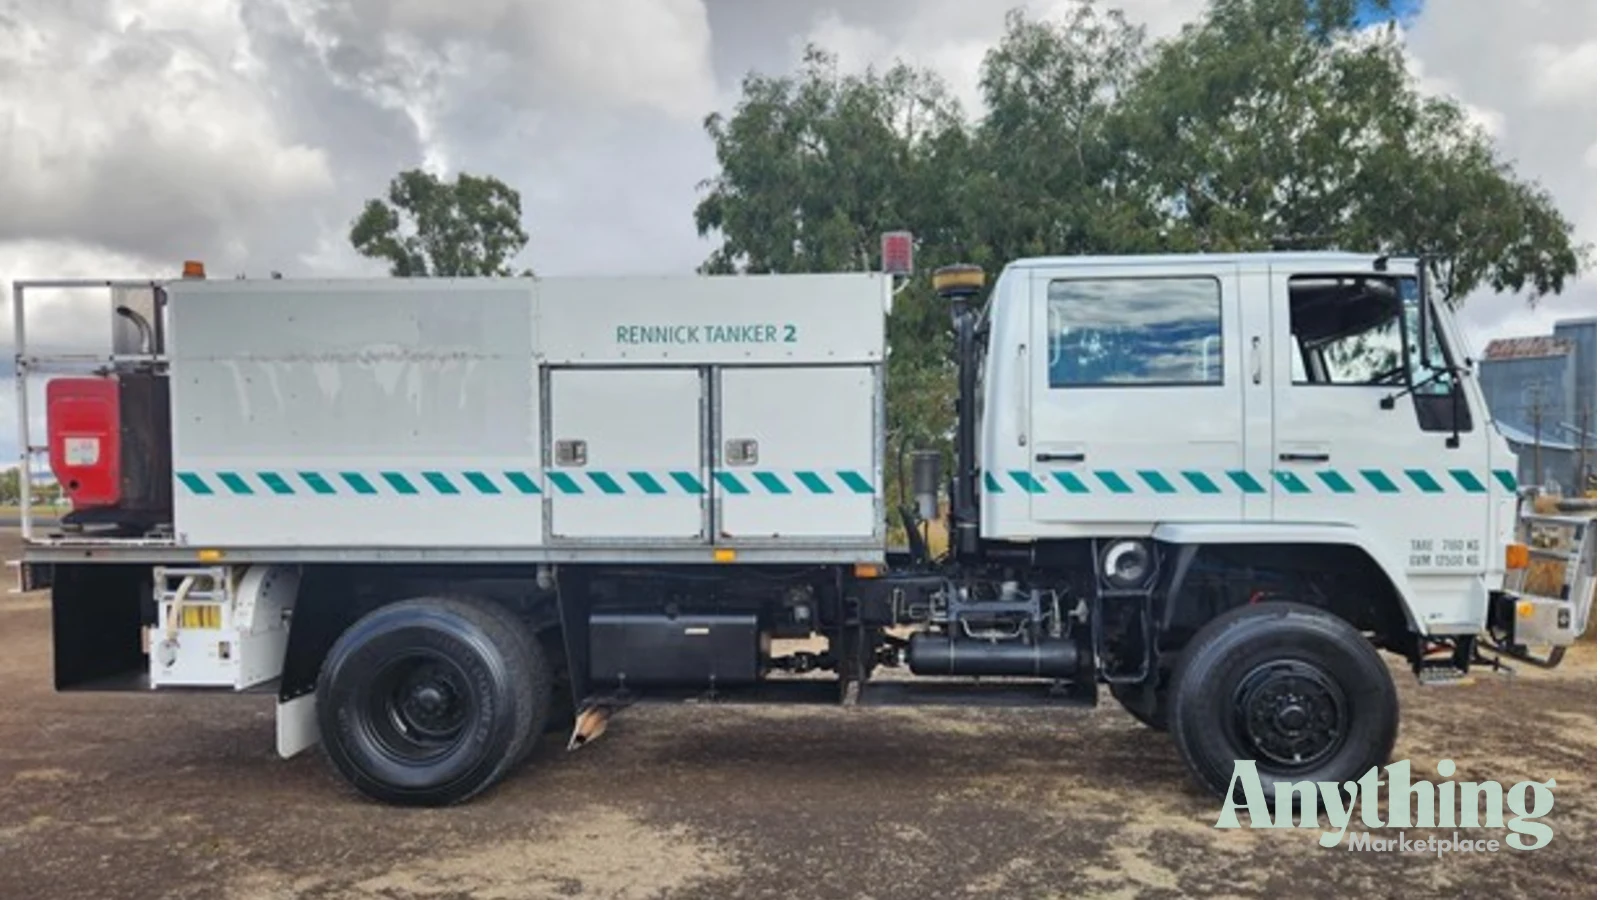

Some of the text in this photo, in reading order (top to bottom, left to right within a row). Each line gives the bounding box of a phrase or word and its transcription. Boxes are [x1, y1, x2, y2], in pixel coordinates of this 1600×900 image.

[616, 324, 797, 344] RENNICK TANKER 2
[1411, 539, 1433, 551] TARE
[1466, 539, 1480, 551] KG
[1409, 554, 1480, 566] GVM 12500 KG
